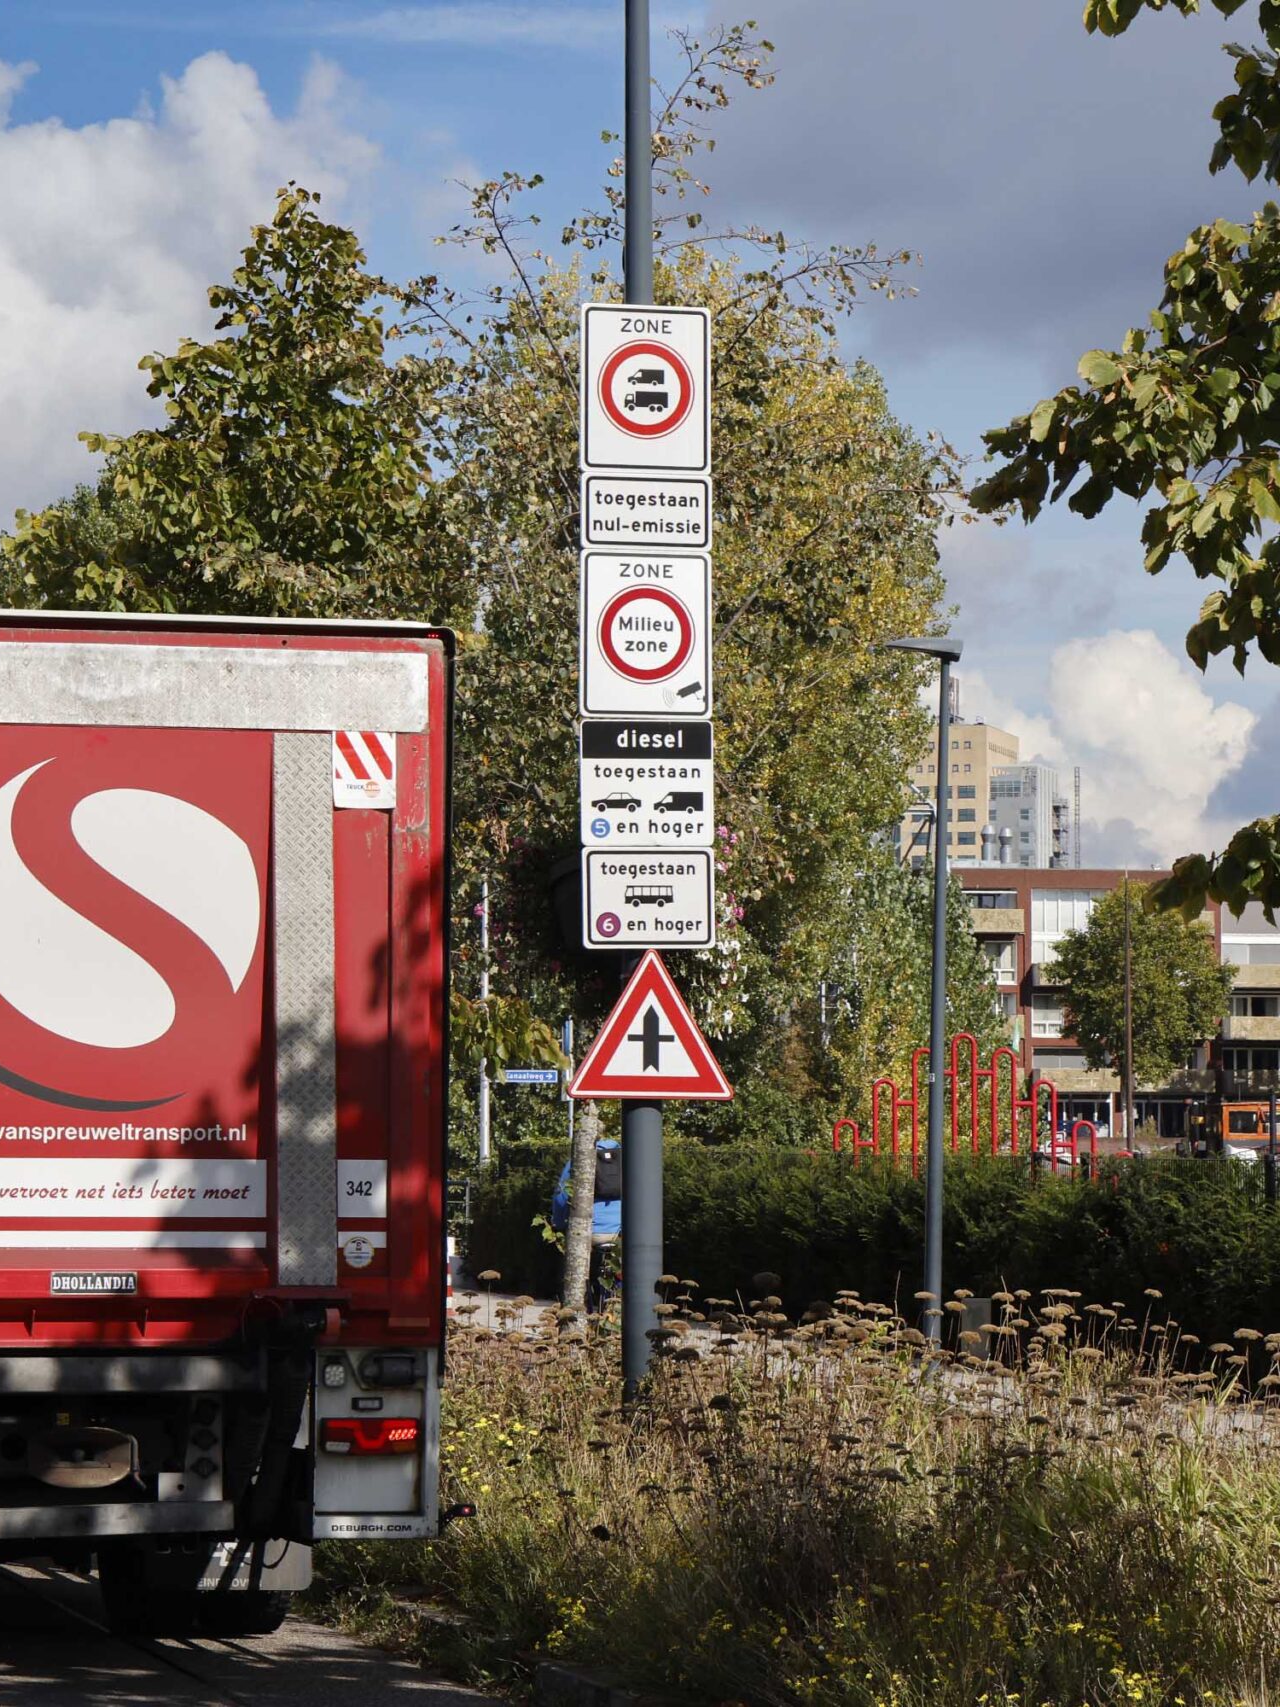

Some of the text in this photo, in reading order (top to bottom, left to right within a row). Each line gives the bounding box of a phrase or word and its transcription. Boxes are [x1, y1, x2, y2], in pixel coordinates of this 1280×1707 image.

[620, 318, 672, 334] ZONE
[595, 490, 700, 510] toegestaan
[593, 517, 701, 534] nul-emissie
[619, 563, 674, 579] ZONE
[619, 616, 674, 632] Milieu
[624, 640, 668, 652] zone
[616, 729, 684, 748] diesel
[594, 765, 701, 782] toegestaan
[593, 820, 705, 838] 5 en hoger
[600, 862, 696, 879] toegestaan
[603, 918, 703, 935] 6 en hoger
[0, 1187, 69, 1199] vervoer
[75, 1184, 105, 1199] net
[112, 1182, 143, 1199] iets
[150, 1179, 196, 1199] beter
[202, 1184, 251, 1199] moet
[346, 1180, 373, 1196] 342
[52, 1276, 136, 1290] DHOLLANDIA
[331, 1524, 413, 1532] DEBURGH.COM
